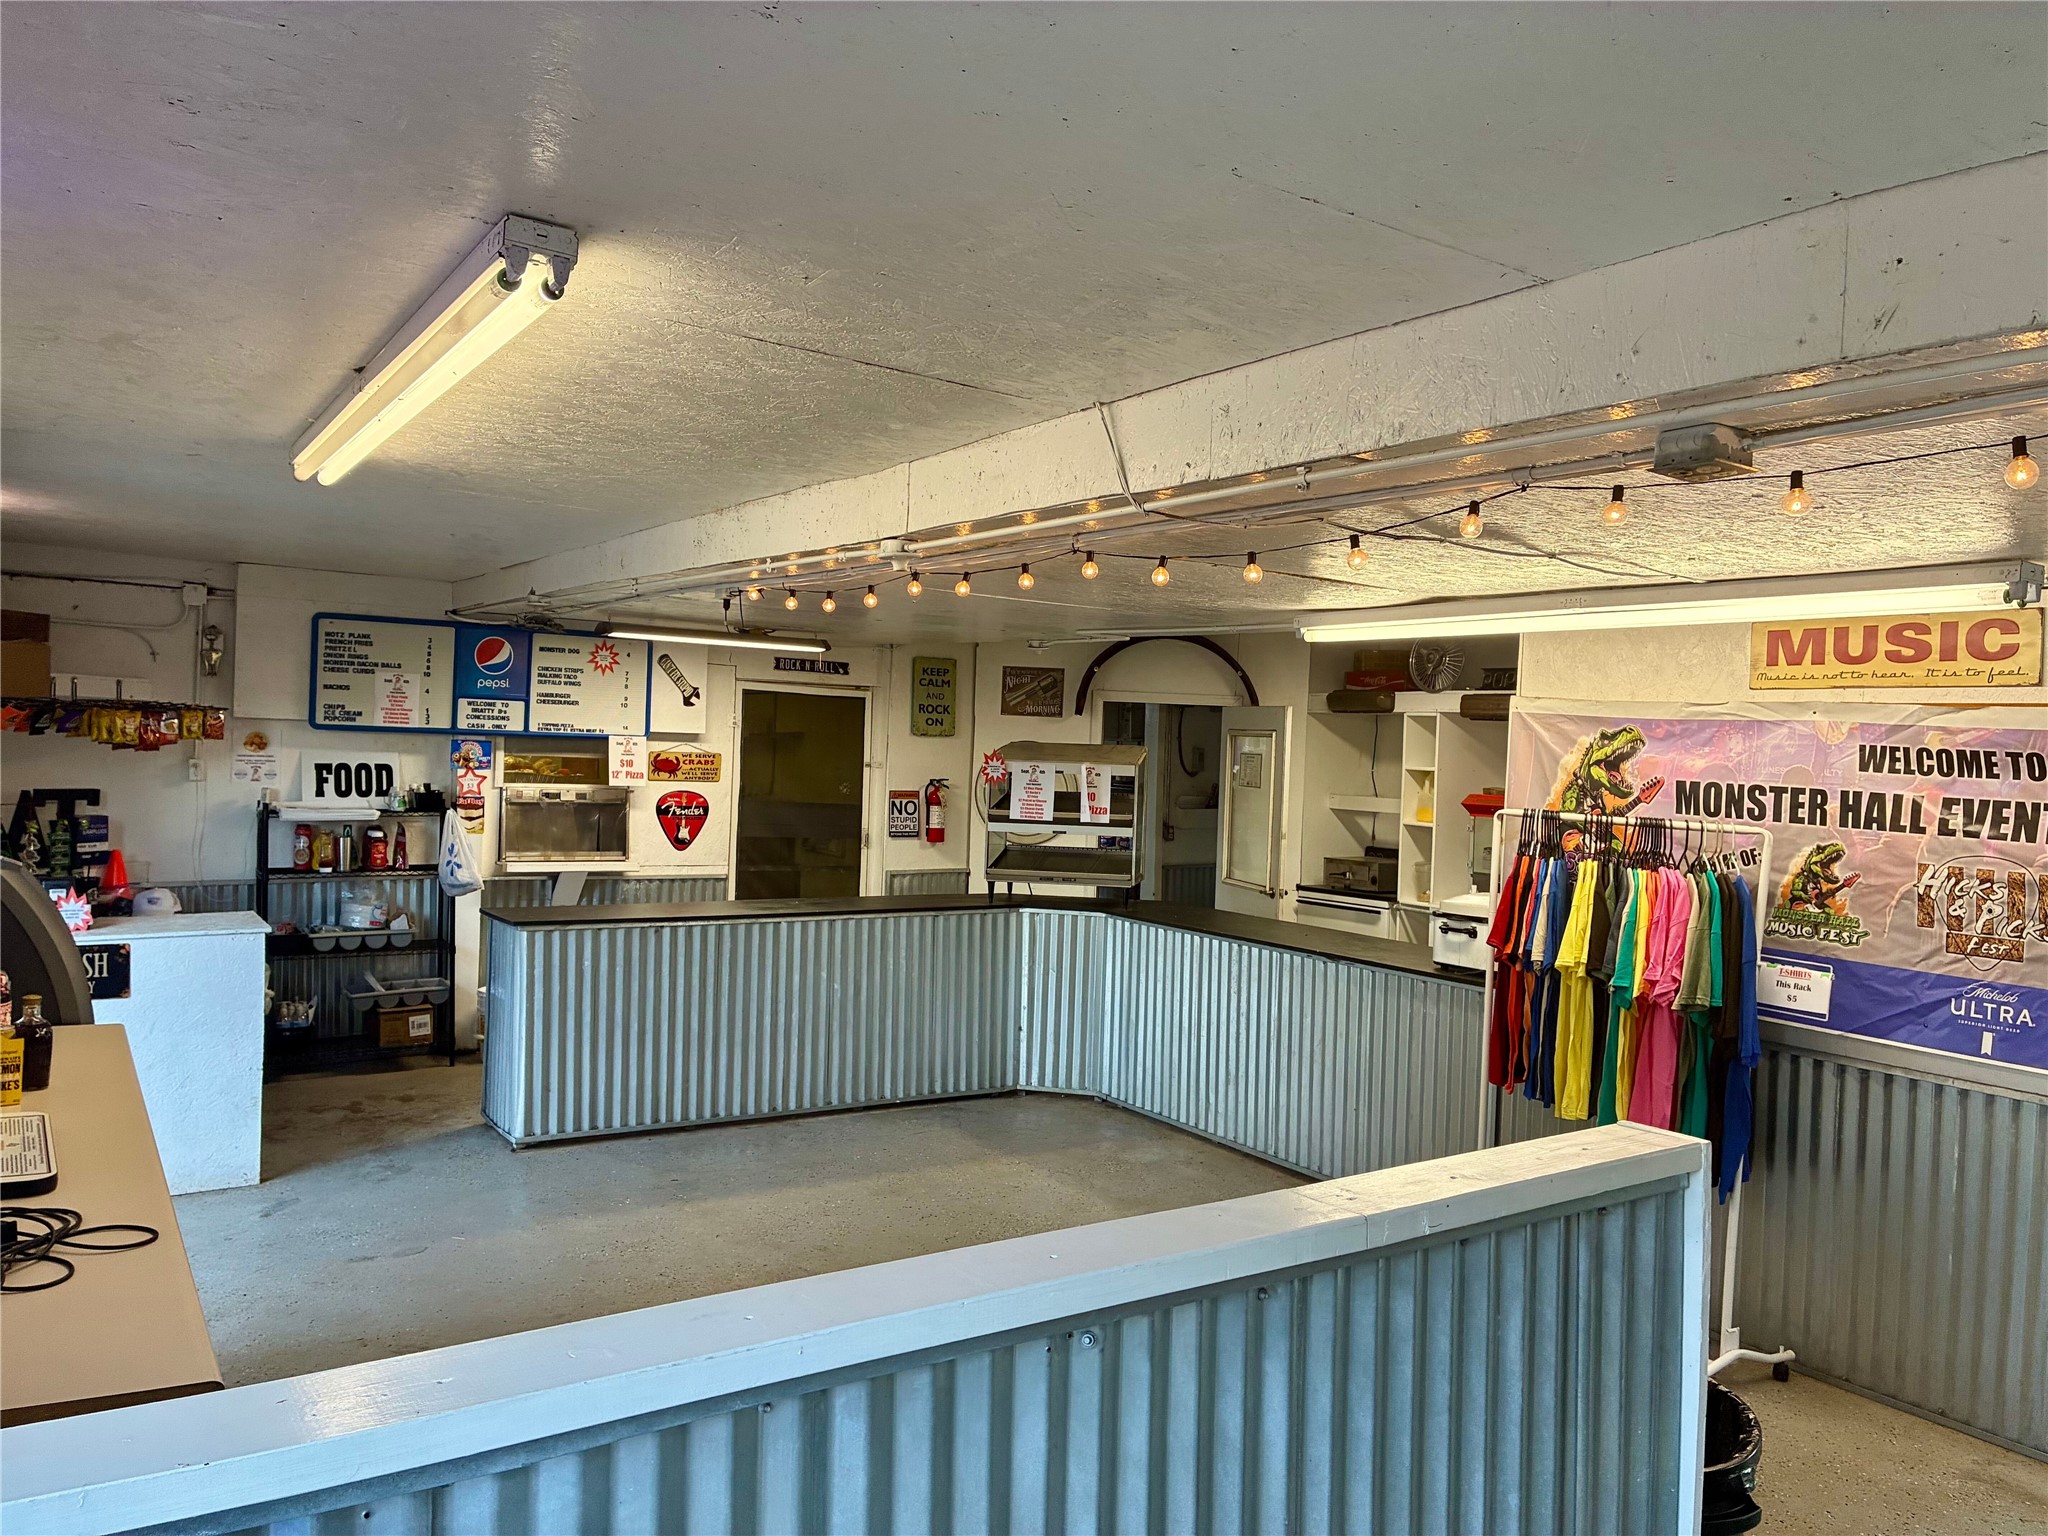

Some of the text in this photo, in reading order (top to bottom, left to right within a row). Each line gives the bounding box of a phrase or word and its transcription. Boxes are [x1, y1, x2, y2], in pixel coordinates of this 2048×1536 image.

[324, 638, 353, 646] FRENCH
[1766, 618, 2021, 667] MUSIC
[922, 667, 950, 677] KEEP
[1756, 666, 2030, 683] Music is not to hear. It is to feel.
[477, 678, 510, 689] pepsi
[919, 678, 950, 688] CALM
[926, 692, 945, 700] AND
[918, 704, 951, 715] ROCK
[1023, 704, 1061, 716] MORNING
[925, 717, 944, 727] ON
[620, 759, 633, 768] $10
[1858, 744, 2047, 782] WELCOME TO
[314, 763, 393, 798] FOOD
[625, 771, 644, 779] Pizza
[661, 801, 704, 818] Fender
[891, 800, 917, 816] NO
[1675, 780, 1829, 827] MONSTER
[1838, 789, 1927, 835] HALL
[1914, 864, 2007, 901] HICKS
[1949, 898, 1967, 919] &
[1772, 907, 1860, 928] MONSTER HALL
[1767, 921, 1866, 945] MUSIC FEST
[1967, 936, 2010, 955] FEST
[1779, 968, 1812, 980] T-SHIRTS
[1776, 980, 1812, 993] This Rack
[1963, 981, 2020, 1003] Michelob
[1786, 994, 1798, 1003] $5
[1950, 997, 2034, 1027] ULTRA
[1958, 1019, 1986, 1027] SUPERIOR
